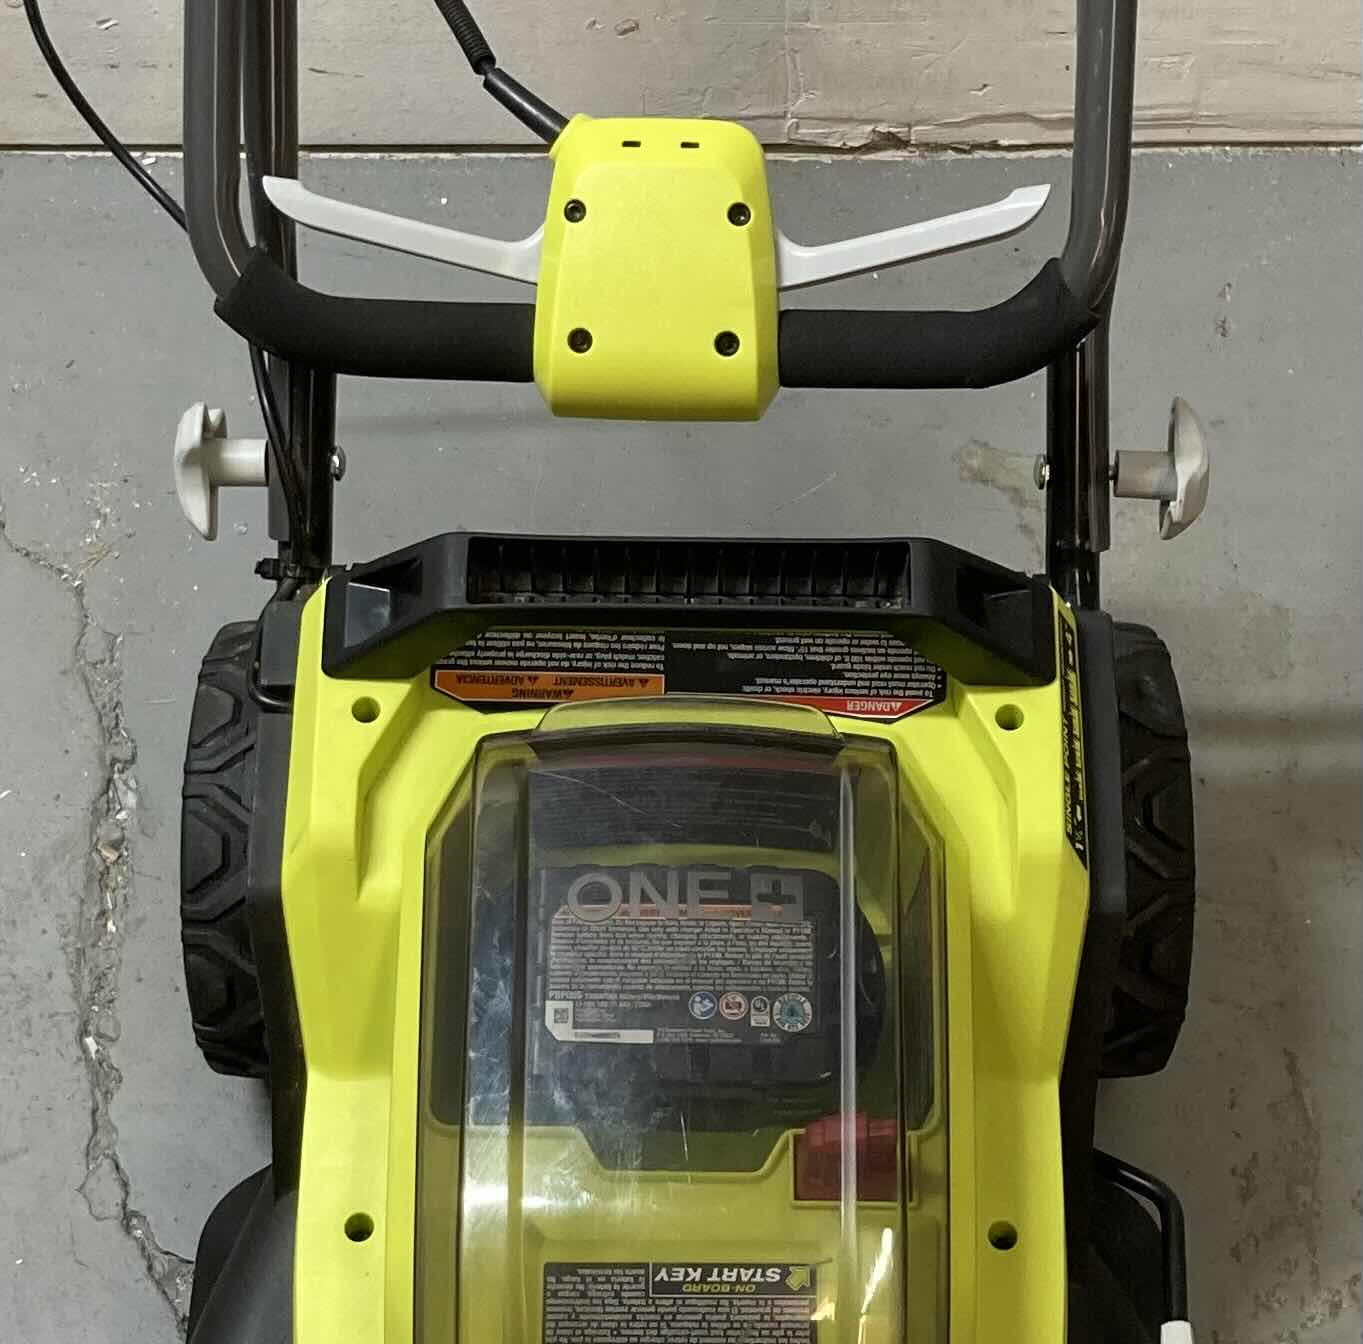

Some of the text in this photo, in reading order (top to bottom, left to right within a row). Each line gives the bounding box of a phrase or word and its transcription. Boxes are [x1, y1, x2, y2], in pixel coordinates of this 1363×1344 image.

[847, 701, 890, 711] DANGER
[654, 1266, 782, 1282] START KEY
[682, 1284, 756, 1292] ON-BOARD
